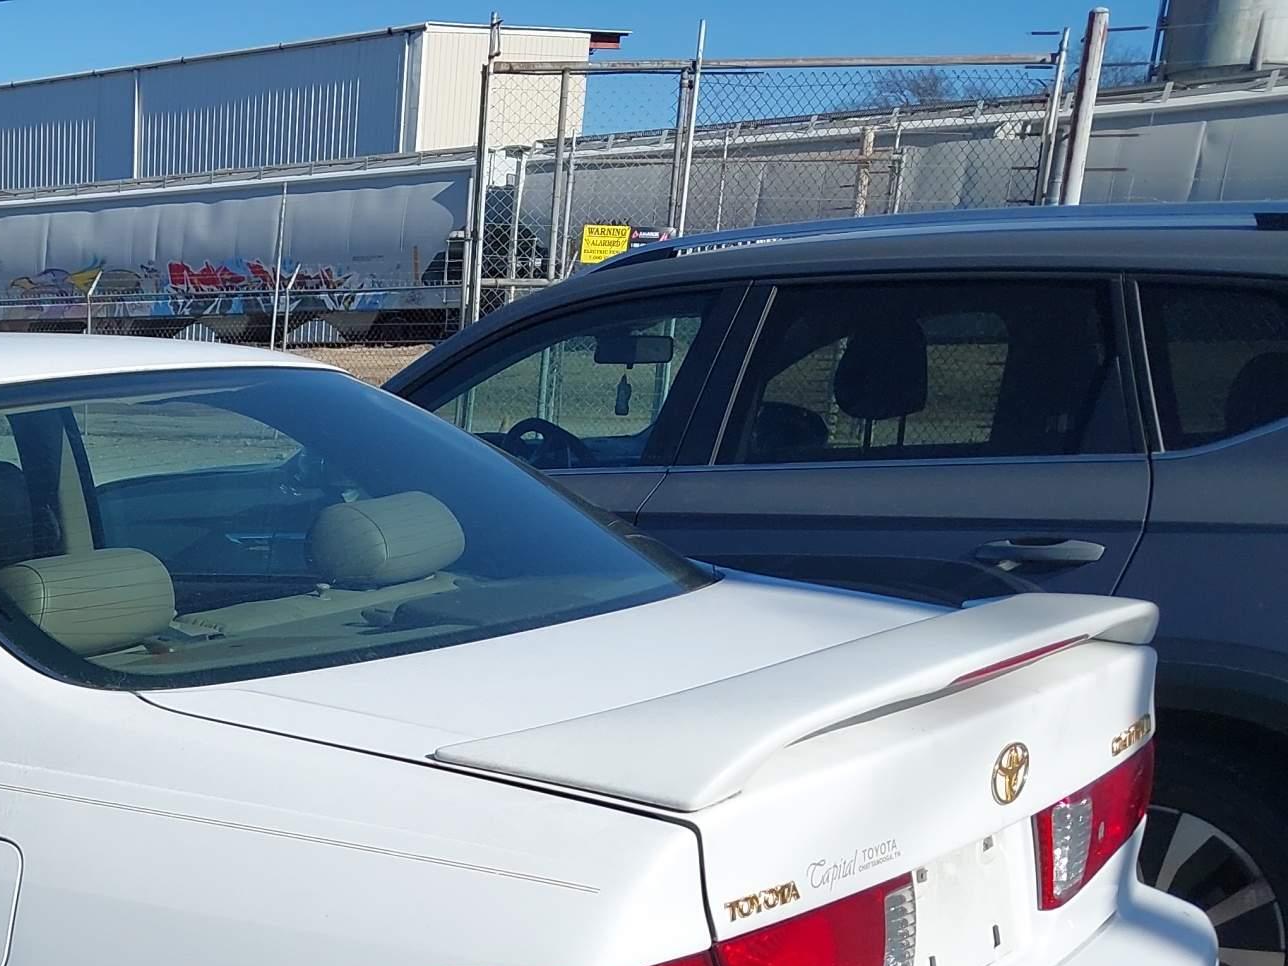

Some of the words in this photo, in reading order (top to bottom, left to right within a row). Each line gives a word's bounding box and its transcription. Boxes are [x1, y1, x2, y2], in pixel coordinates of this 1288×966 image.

[587, 227, 627, 237] WARNING
[806, 849, 858, 891] Capital
[861, 839, 898, 863] TOYOTA
[723, 879, 801, 922] TOYOTA
